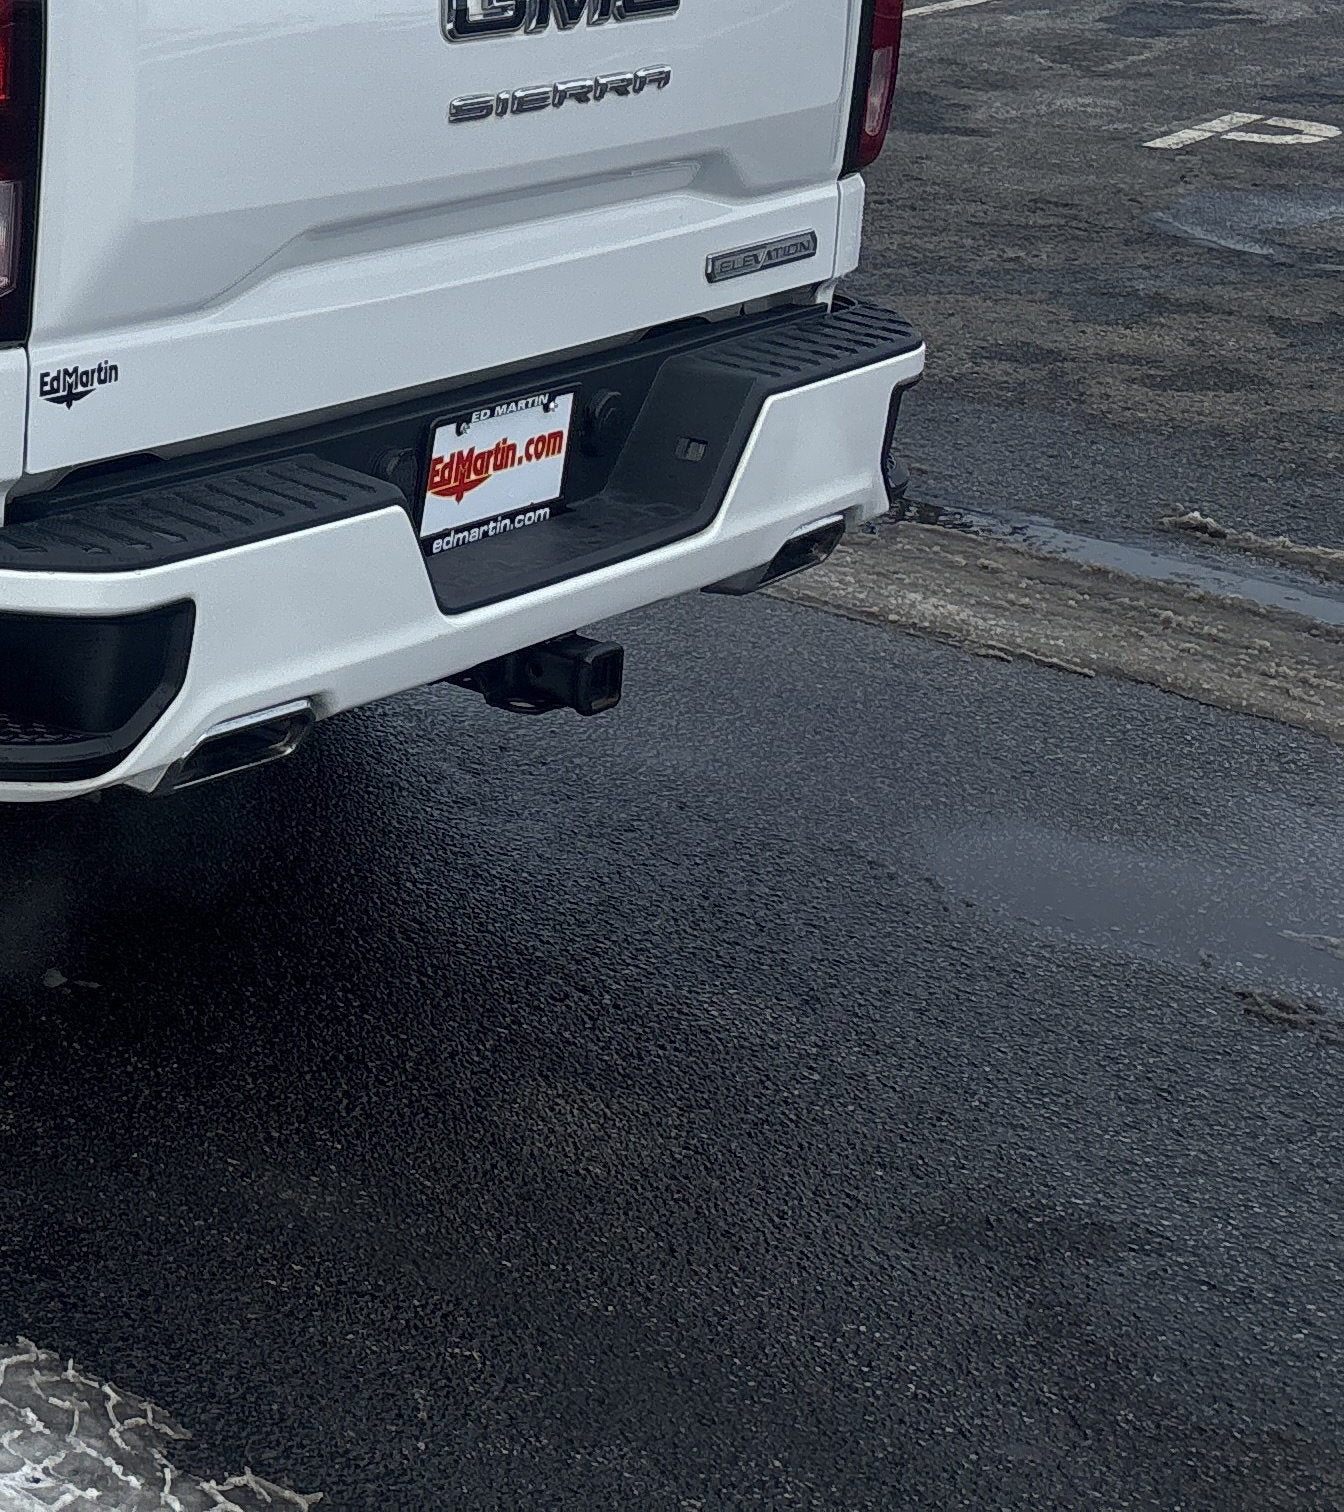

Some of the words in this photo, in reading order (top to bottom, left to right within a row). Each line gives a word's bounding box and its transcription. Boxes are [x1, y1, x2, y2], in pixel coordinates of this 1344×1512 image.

[448, 64, 672, 125] SIERRA
[719, 240, 811, 274] ELEVATION
[471, 409, 491, 424] ED
[493, 392, 550, 418] MARTIN
[431, 506, 551, 555] edmartin.com
